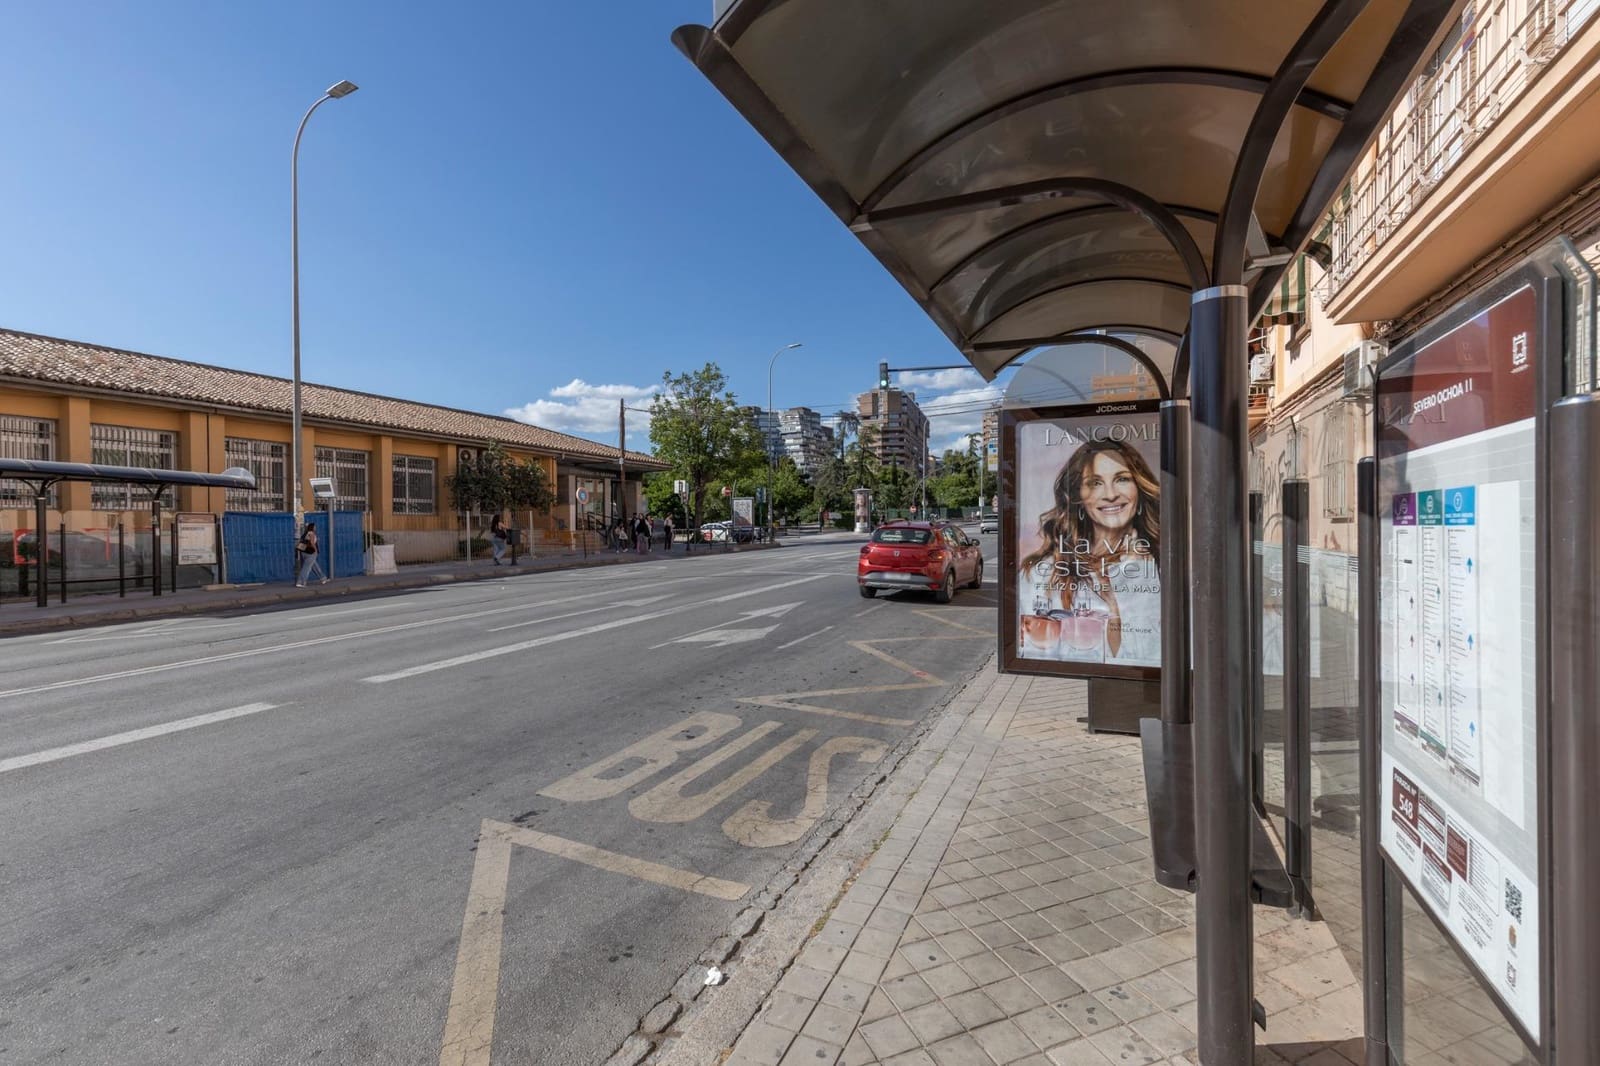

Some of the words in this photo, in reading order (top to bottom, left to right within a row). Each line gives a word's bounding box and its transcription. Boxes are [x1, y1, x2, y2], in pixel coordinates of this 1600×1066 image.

[1414, 394, 1436, 414] SEVERO
[1437, 382, 1464, 404] OCHOA
[1059, 534, 1090, 554] La
[1103, 534, 1151, 555] vie
[1035, 559, 1090, 577] est
[1101, 557, 1157, 579] bell
[1035, 583, 1067, 592] FELIZ
[1093, 582, 1110, 592] DE
[1114, 584, 1130, 593] LA
[1132, 583, 1160, 594] MAD
[536, 710, 890, 848] BUS
[1399, 793, 1413, 820] 548
